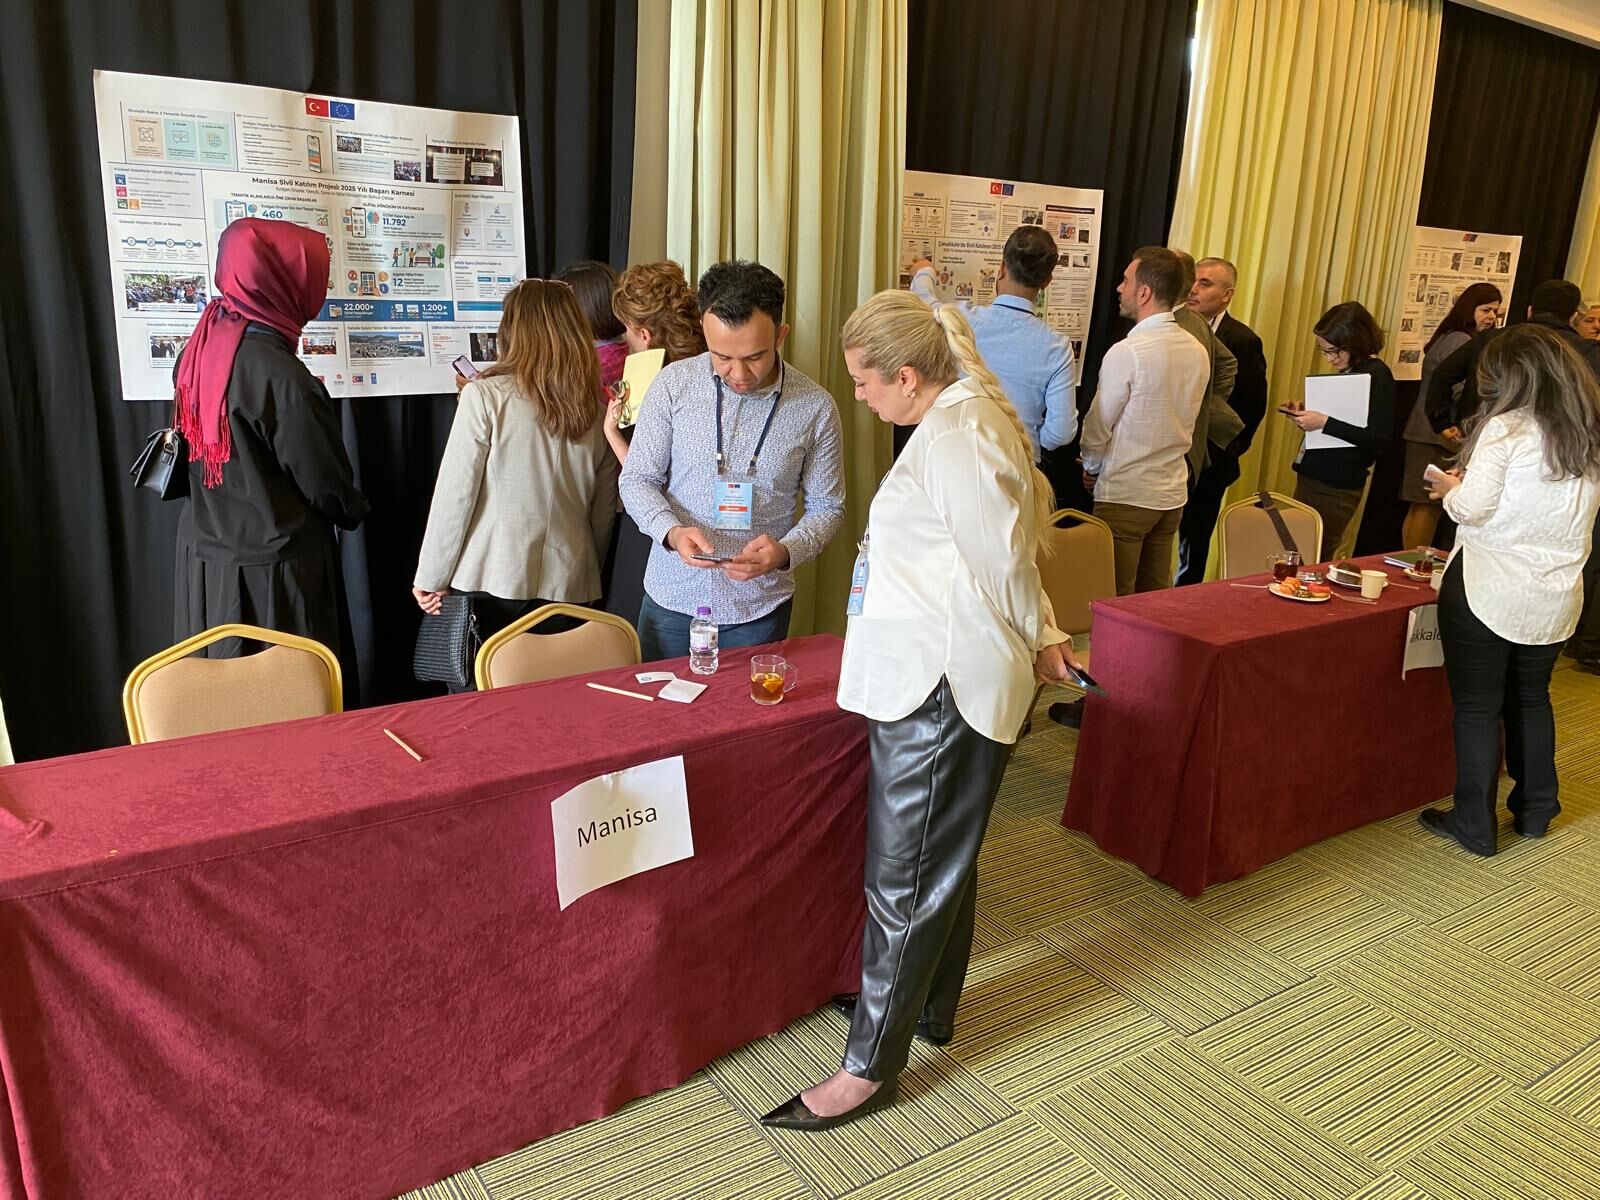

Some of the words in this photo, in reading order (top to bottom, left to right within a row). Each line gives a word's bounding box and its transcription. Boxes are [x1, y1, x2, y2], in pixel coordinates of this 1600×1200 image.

[252, 177, 278, 185] Manisa
[295, 180, 317, 189] Katılım
[318, 182, 339, 192] Projesi:
[382, 218, 406, 226] 11.792
[393, 278, 403, 287] 12
[577, 806, 658, 848] Manisa
